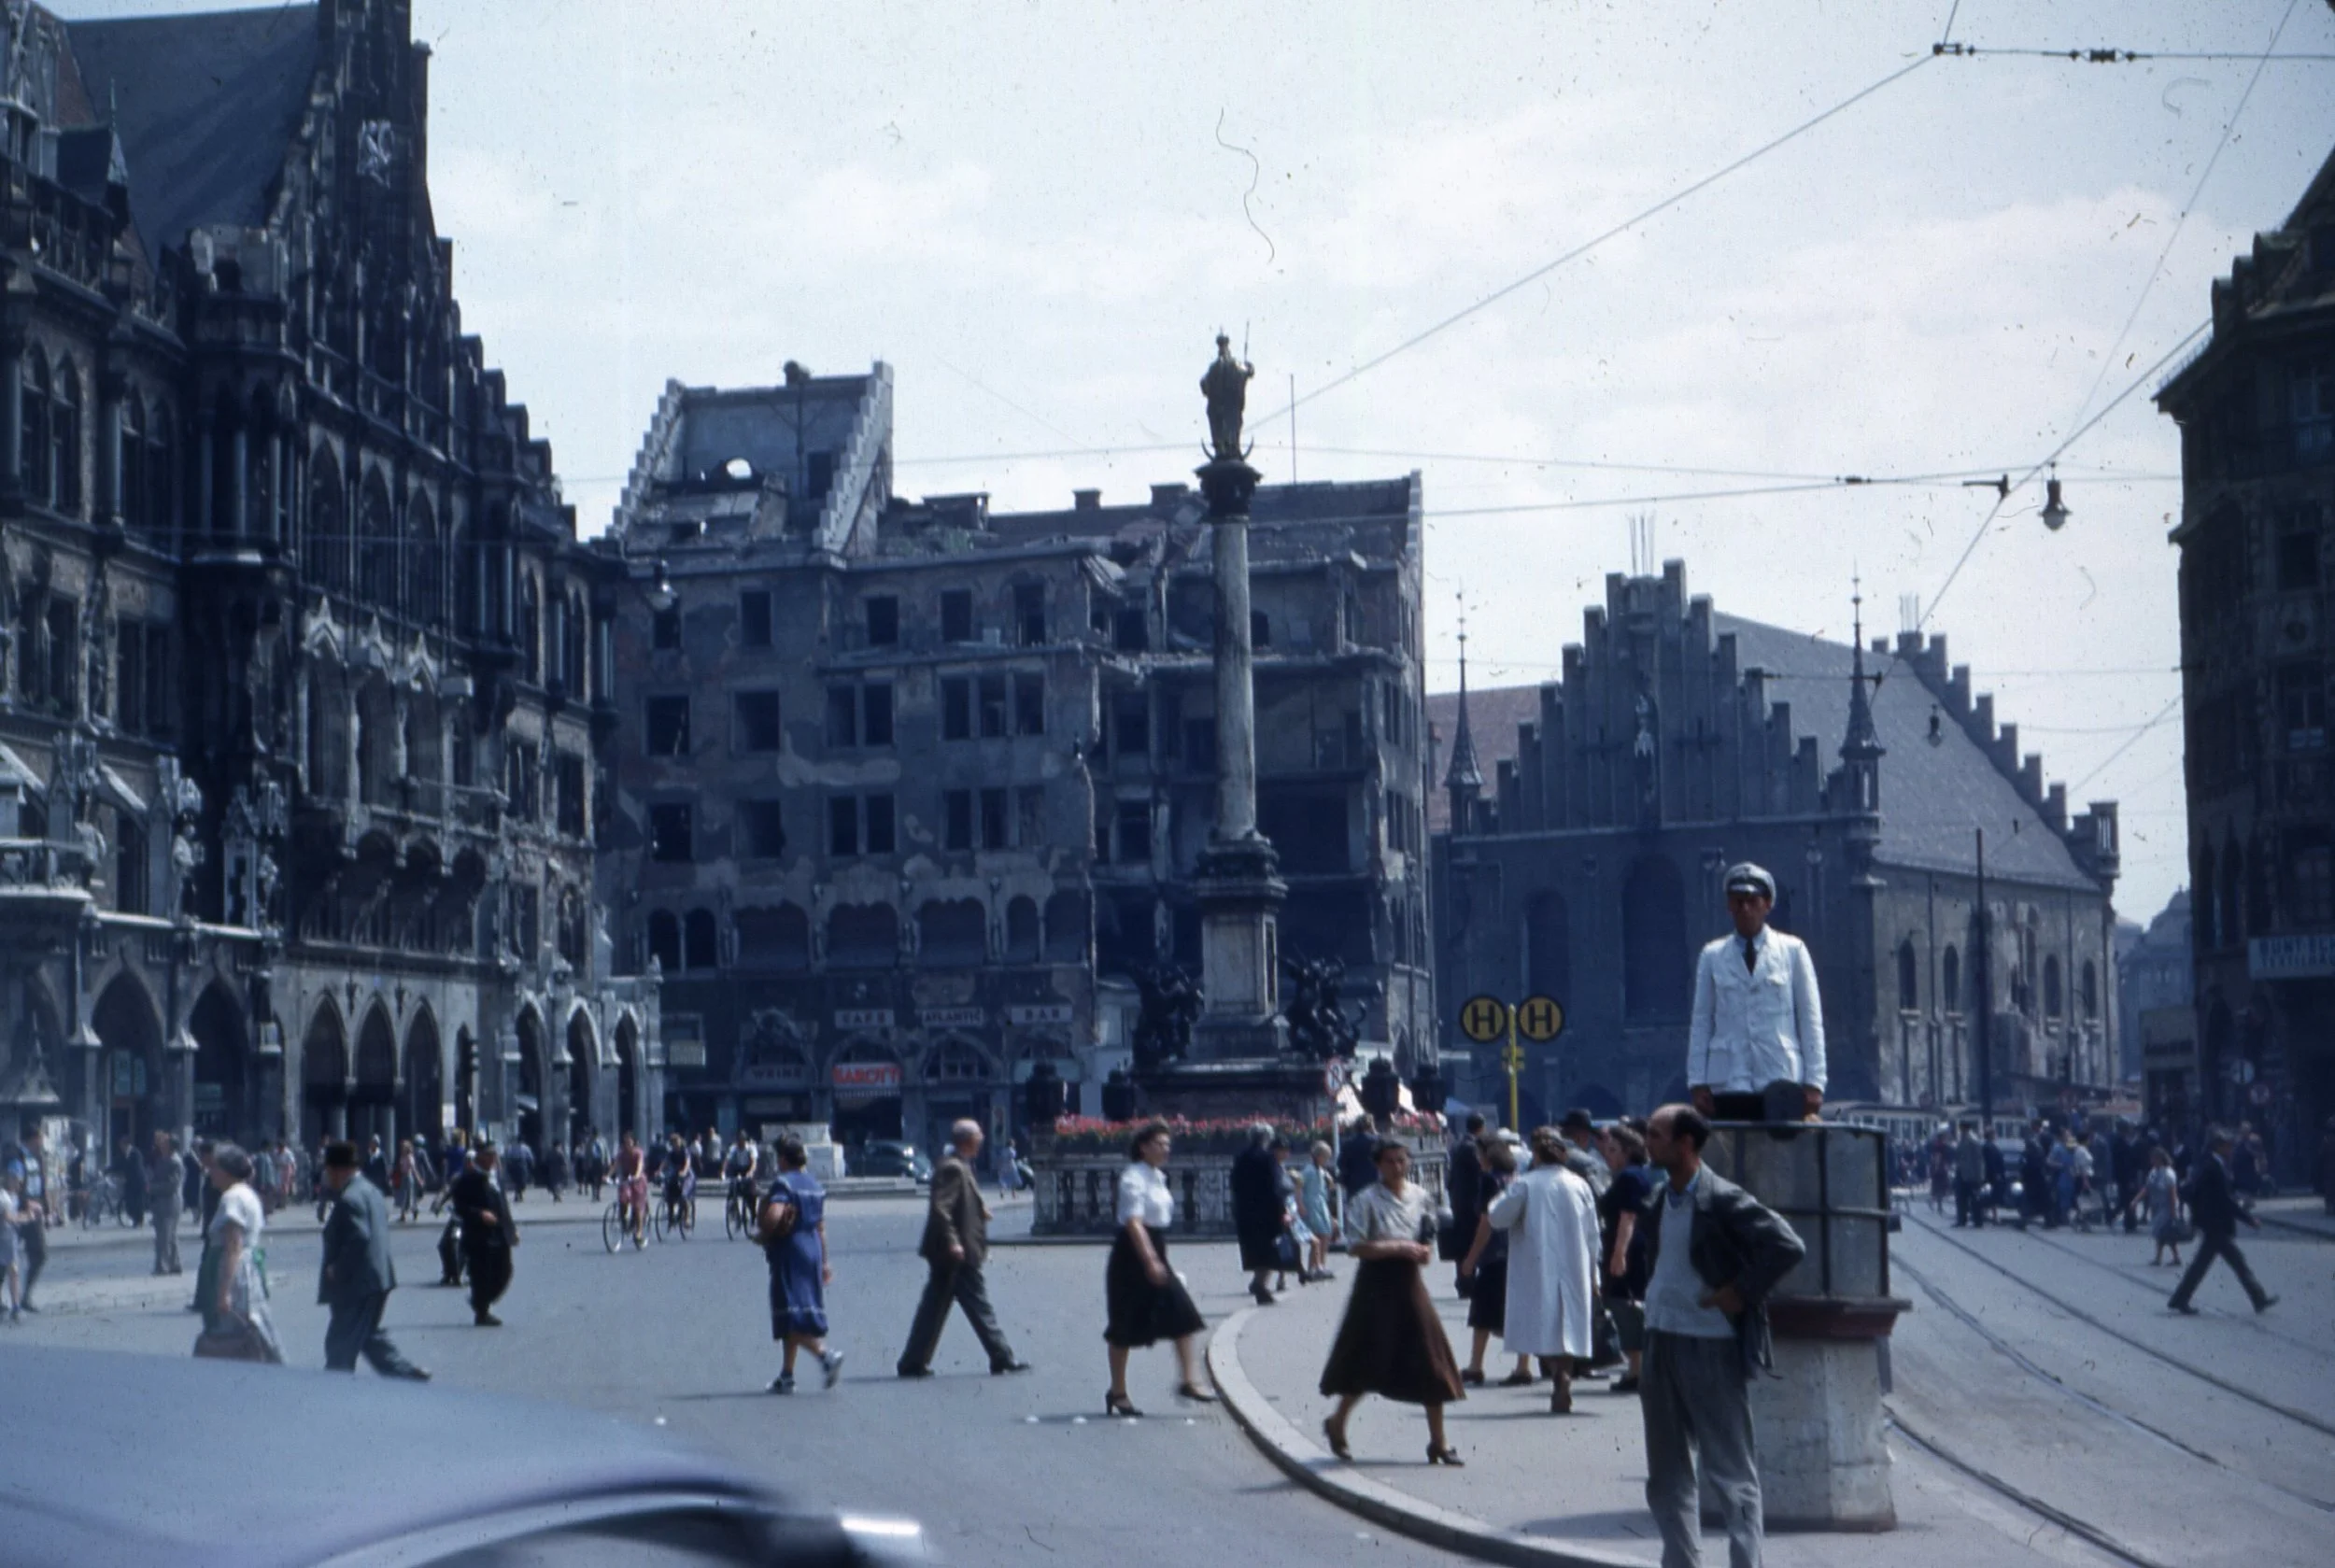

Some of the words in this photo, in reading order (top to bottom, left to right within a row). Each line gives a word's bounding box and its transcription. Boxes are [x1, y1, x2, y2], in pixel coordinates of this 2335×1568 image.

[924, 1010, 982, 1024] ATLANTIC
[1024, 1008, 1060, 1021] BAR
[1471, 1003, 1495, 1034] H
[1528, 1003, 1552, 1034] H
